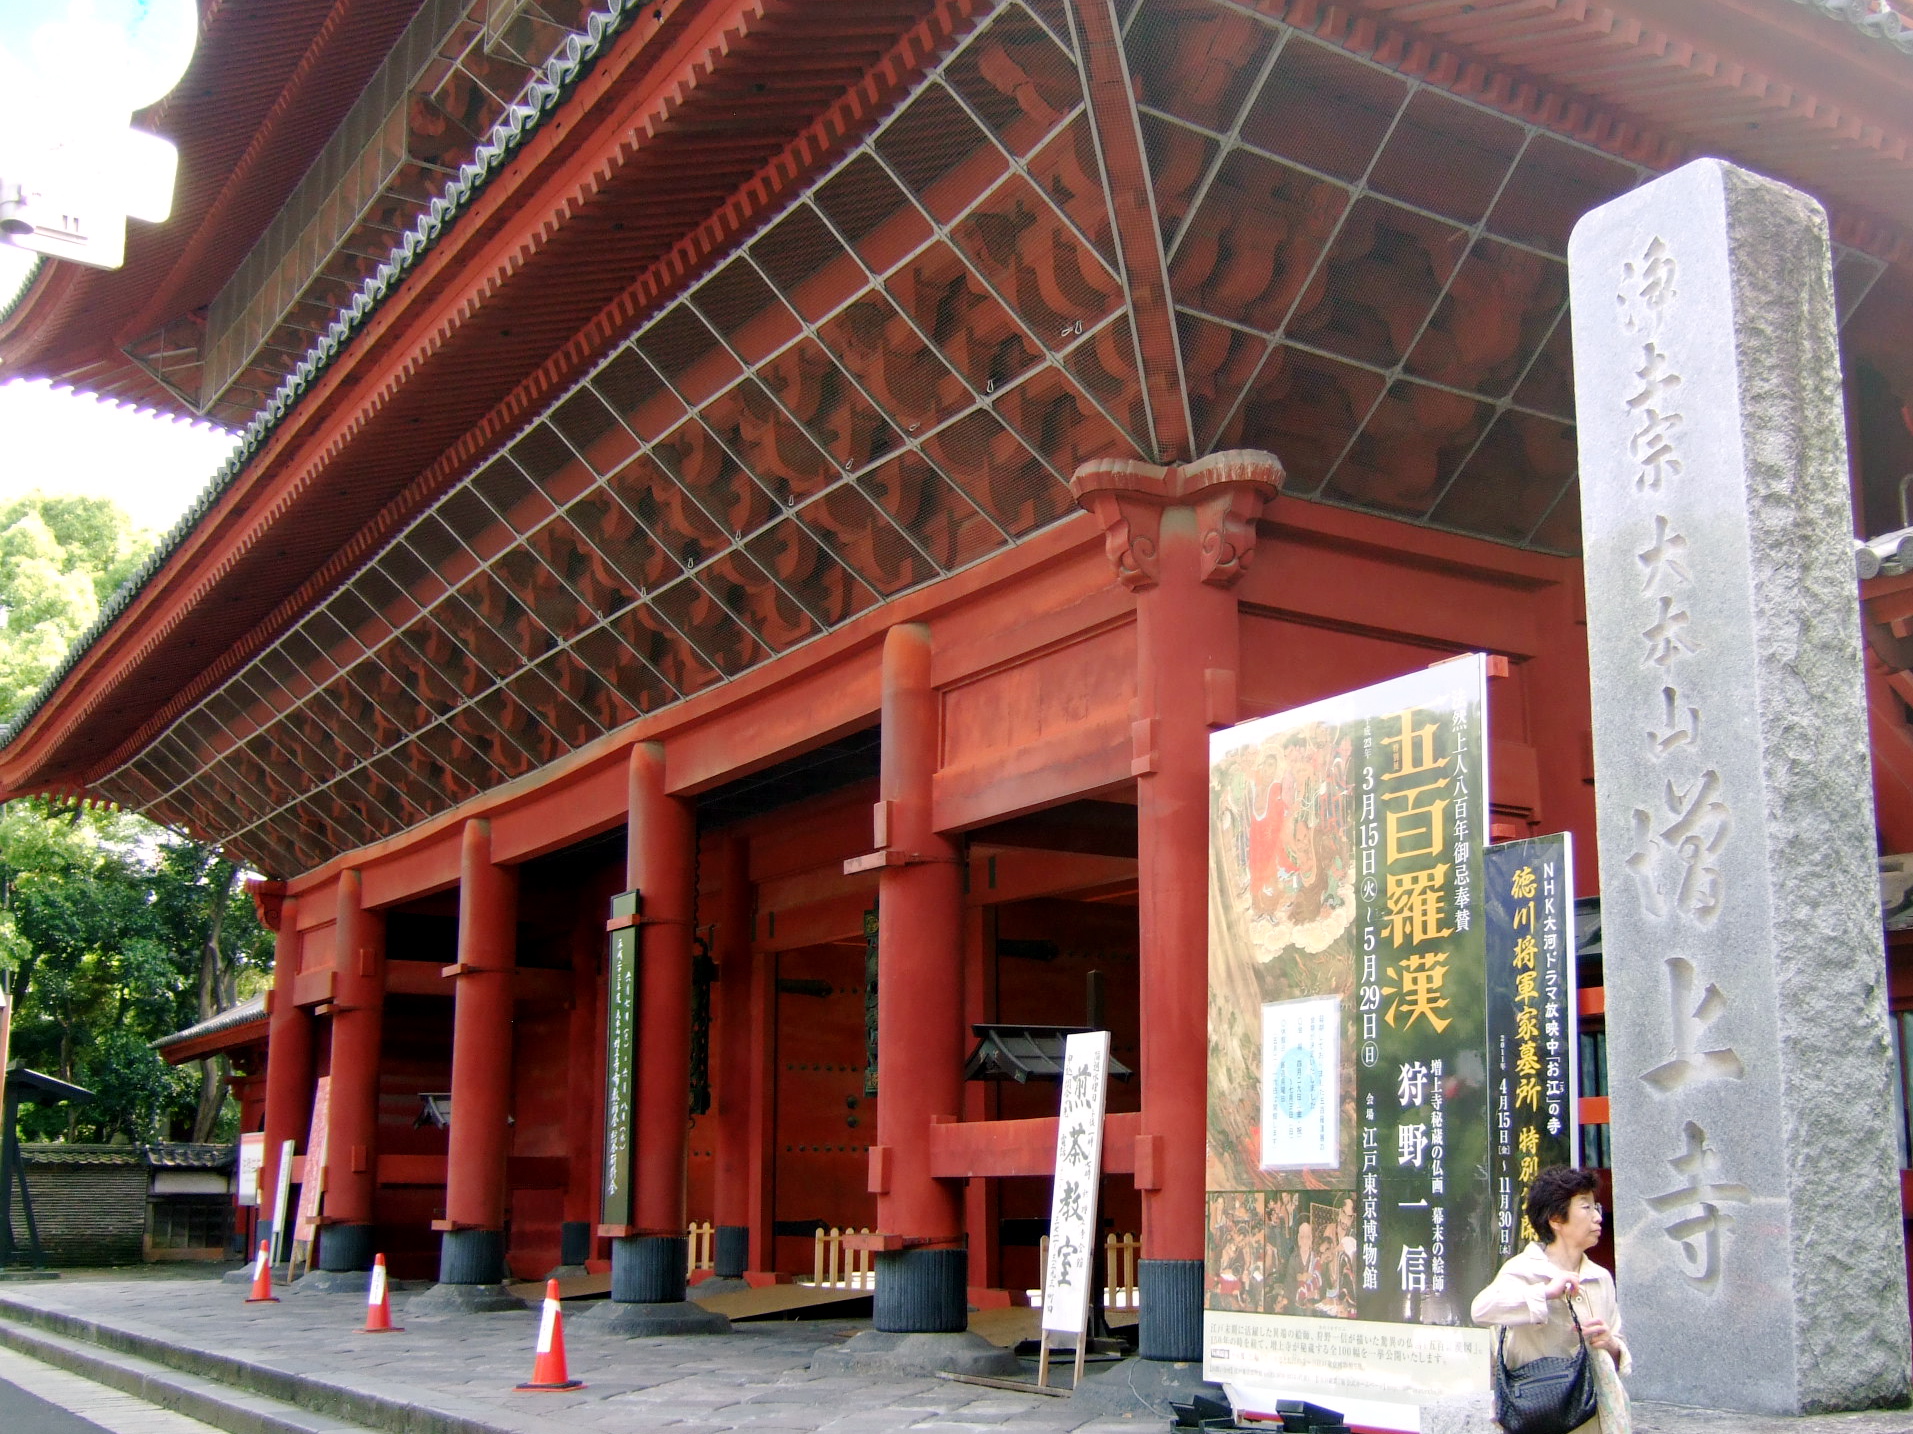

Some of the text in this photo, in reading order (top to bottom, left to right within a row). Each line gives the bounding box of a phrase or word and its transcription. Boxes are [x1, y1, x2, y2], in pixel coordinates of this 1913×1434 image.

[1379, 693, 1455, 1035] 五百羅漢
[1451, 688, 1471, 934] 法然上人八百年御忌奉賛
[1365, 1092, 1374, 1120] 会場
[1511, 866, 1542, 1113] 徳川将軍家墓所
[1543, 862, 1562, 1135] NHK大河ドラマ放映中「お江」の寺
[1058, 1064, 1093, 1288] 煎茶教室
[1362, 1126, 1378, 1290] 江戸東京博物館
[1397, 1061, 1429, 1292] 狩野一信
[1430, 1059, 1445, 1292] 増上寺秘蔵の仏画 幕末の絵師
